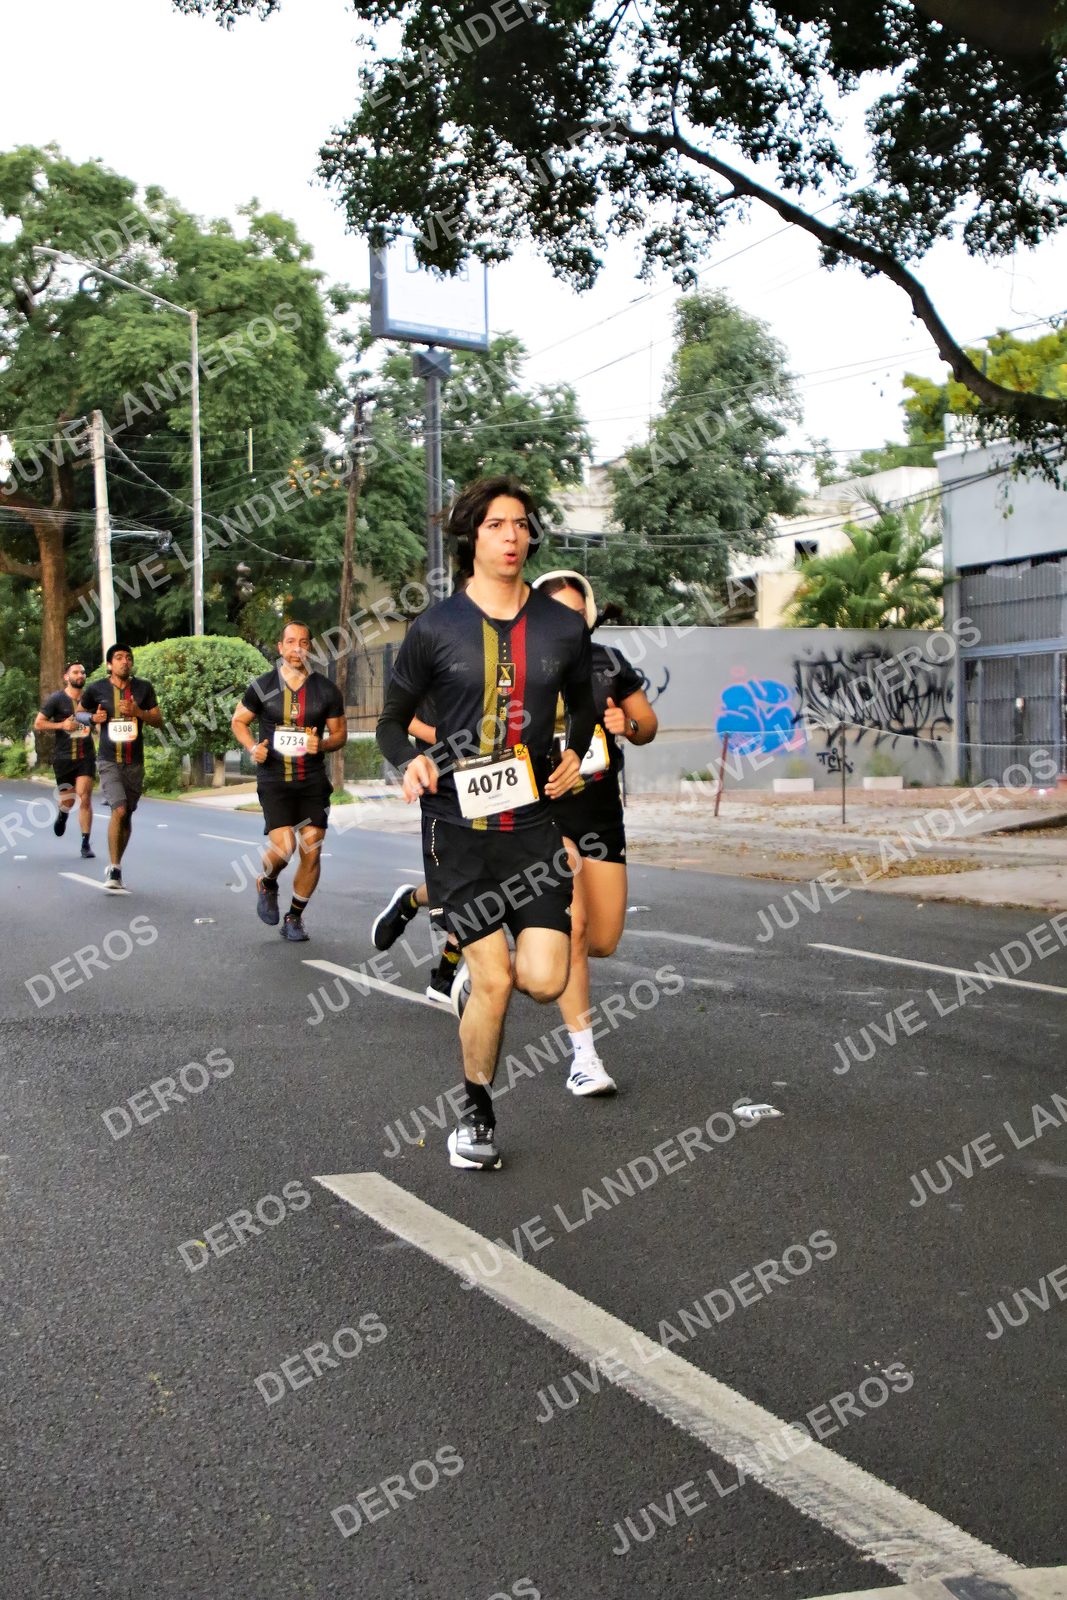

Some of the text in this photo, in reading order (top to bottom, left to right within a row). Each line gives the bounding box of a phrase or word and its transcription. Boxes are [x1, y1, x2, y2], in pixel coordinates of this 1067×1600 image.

[112, 723, 133, 733] 4308
[279, 735, 304, 747] 5734
[467, 766, 519, 797] 4078
